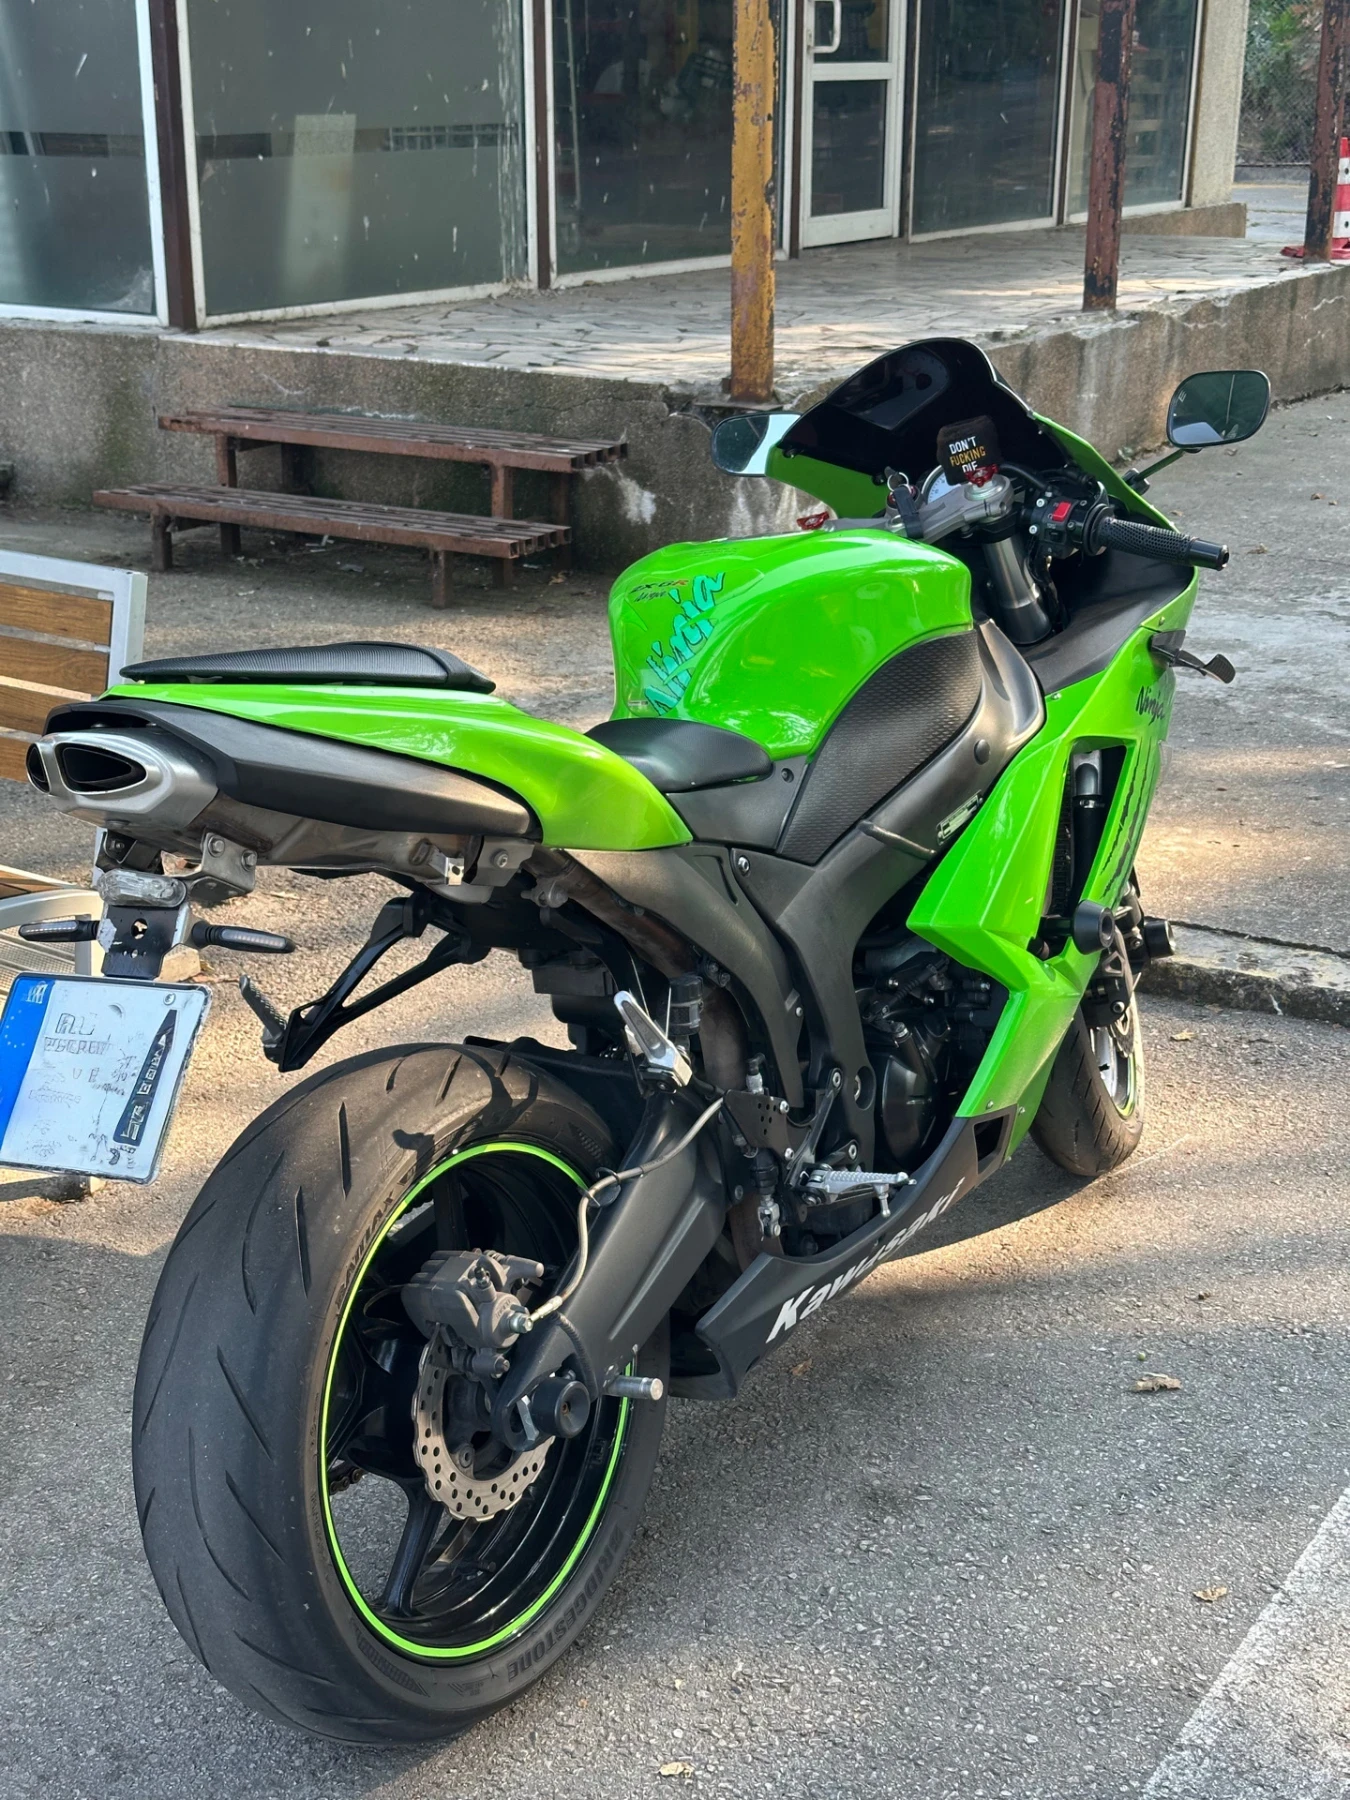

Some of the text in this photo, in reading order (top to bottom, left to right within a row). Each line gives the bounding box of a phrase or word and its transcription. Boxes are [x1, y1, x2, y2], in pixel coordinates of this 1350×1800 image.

[949, 436, 977, 454] DON'T
[949, 446, 986, 467] FUCKING
[644, 571, 725, 716] Ninja
[1135, 686, 1166, 726] Ninja
[765, 1176, 966, 1344] Kawasaki
[507, 1524, 625, 1683] BRIDGESTONE
